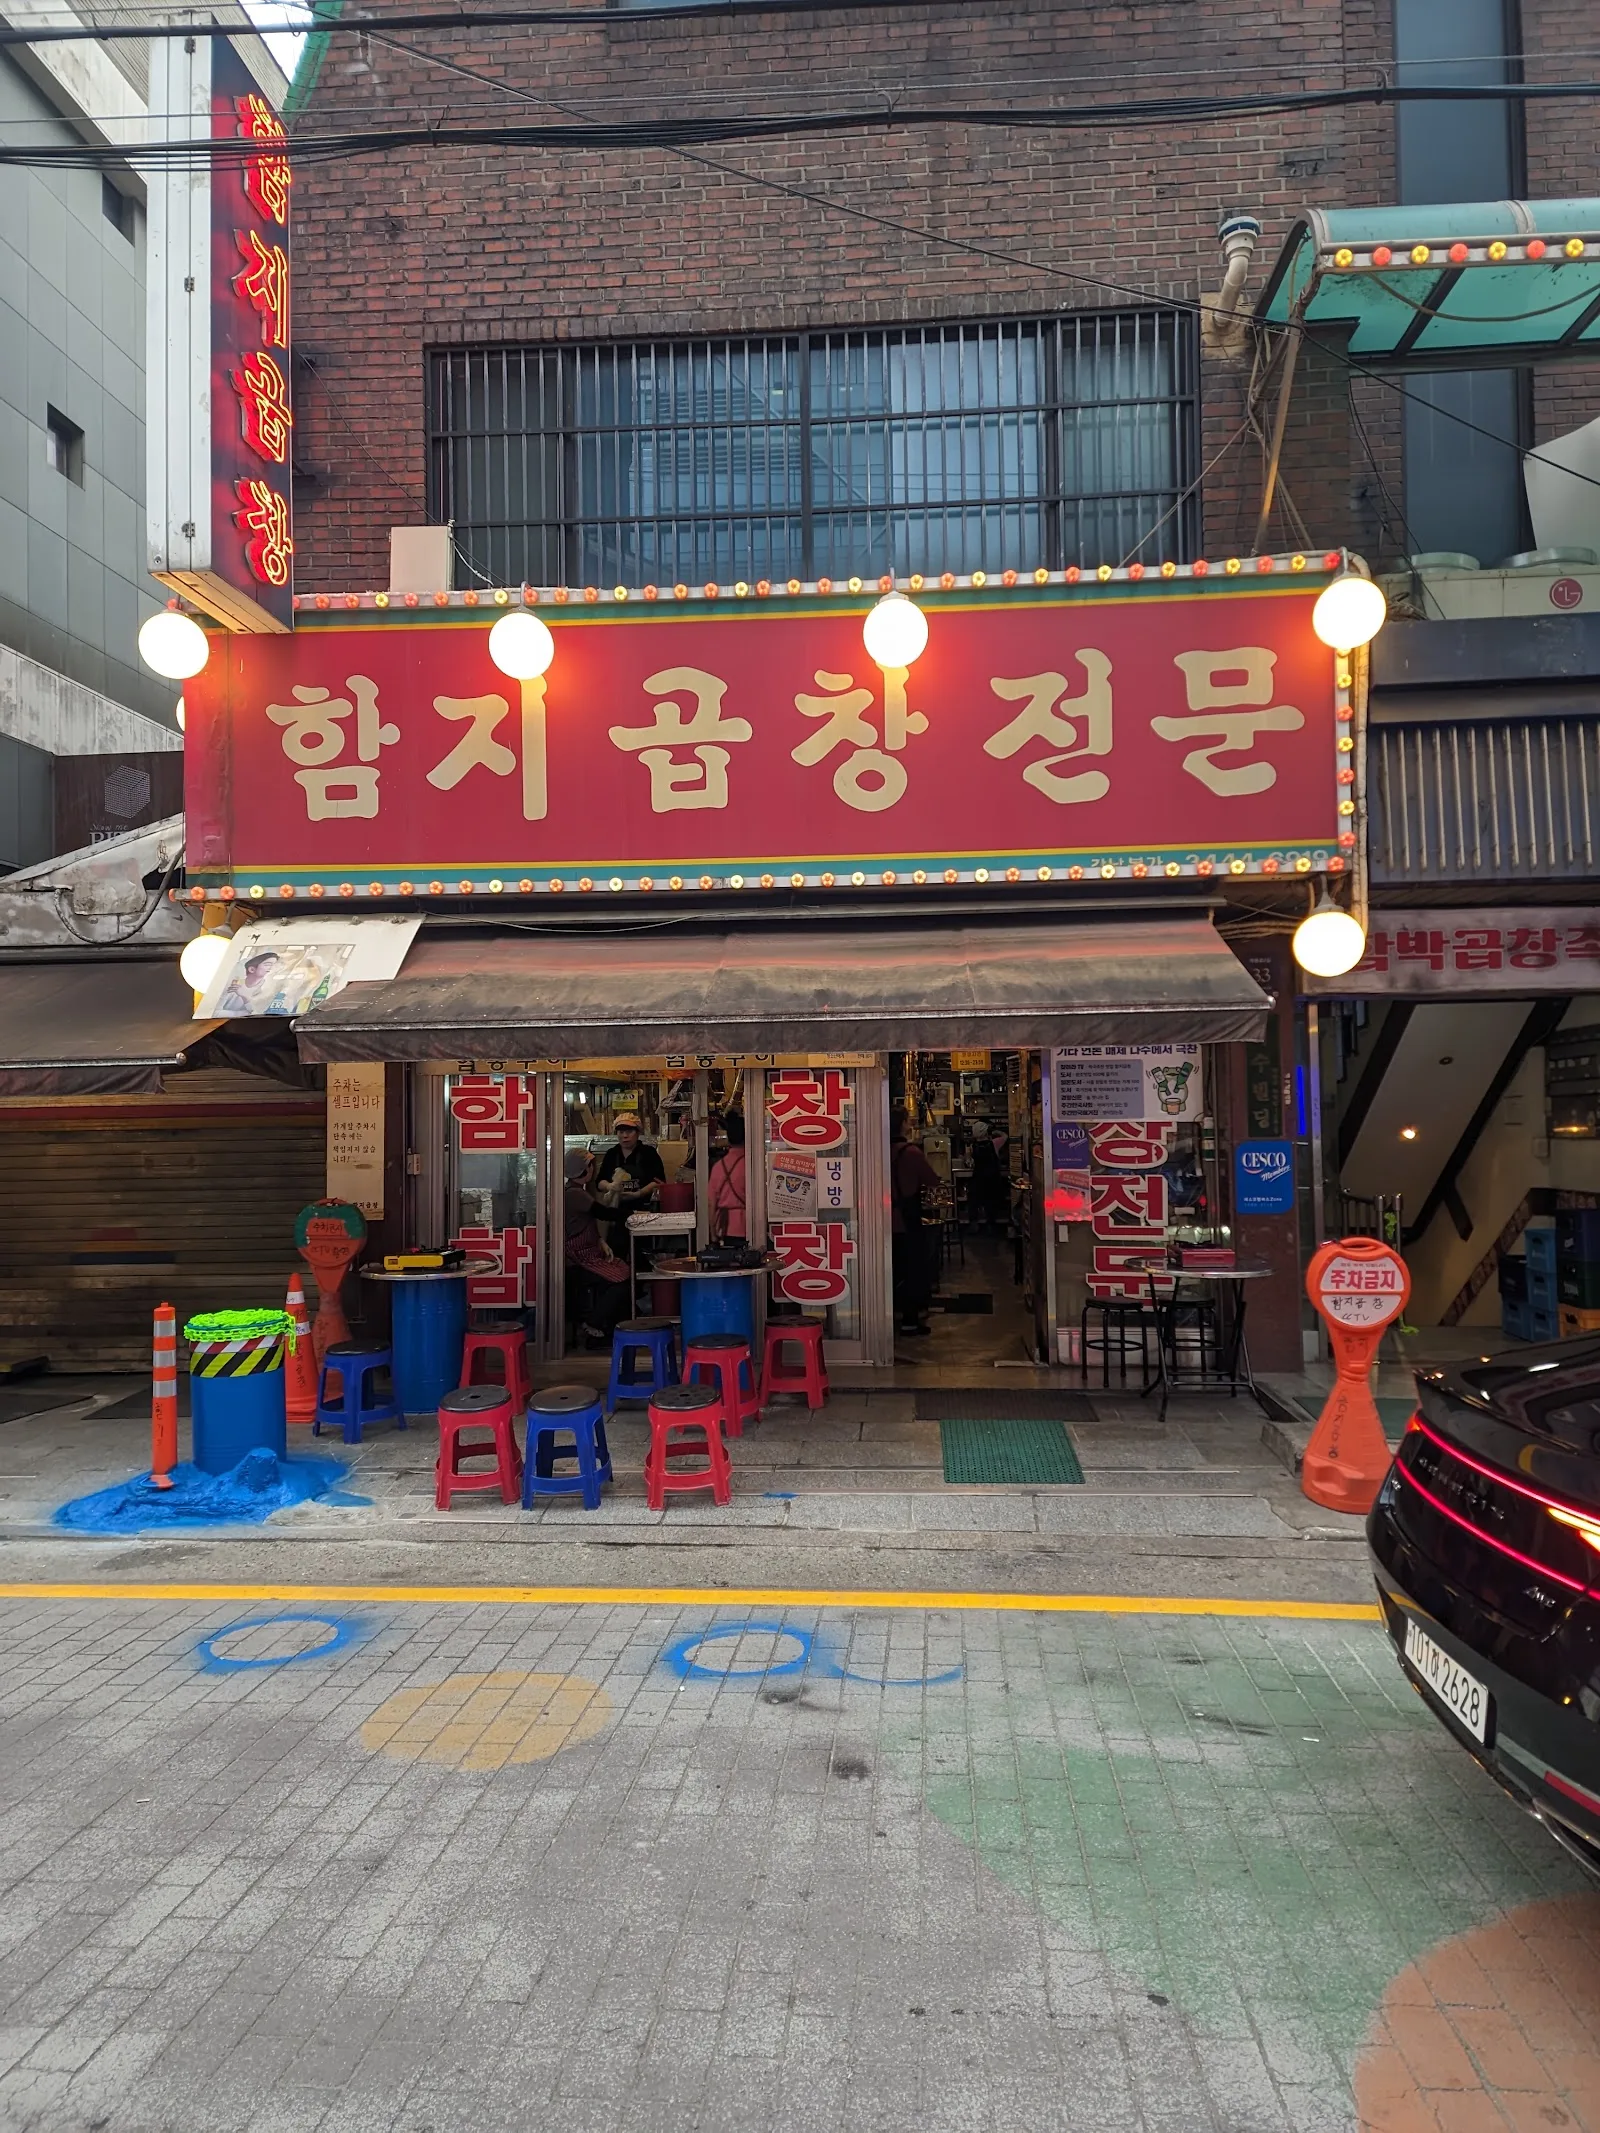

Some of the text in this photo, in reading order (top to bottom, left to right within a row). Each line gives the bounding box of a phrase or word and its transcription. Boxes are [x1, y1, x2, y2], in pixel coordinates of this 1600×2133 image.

[333, 1079, 361, 1092] 주차는
[333, 1095, 380, 1109] 셀프입니다
[355, 1122, 377, 1131] 주차시
[1056, 1129, 1085, 1139] CESCO
[333, 1145, 360, 1154] 책임지지
[1242, 1152, 1287, 1167] CESCO
[1261, 1165, 1291, 1182] Members
[826, 1160, 843, 1206] 냉방
[1331, 1269, 1396, 1289] 주차금지
